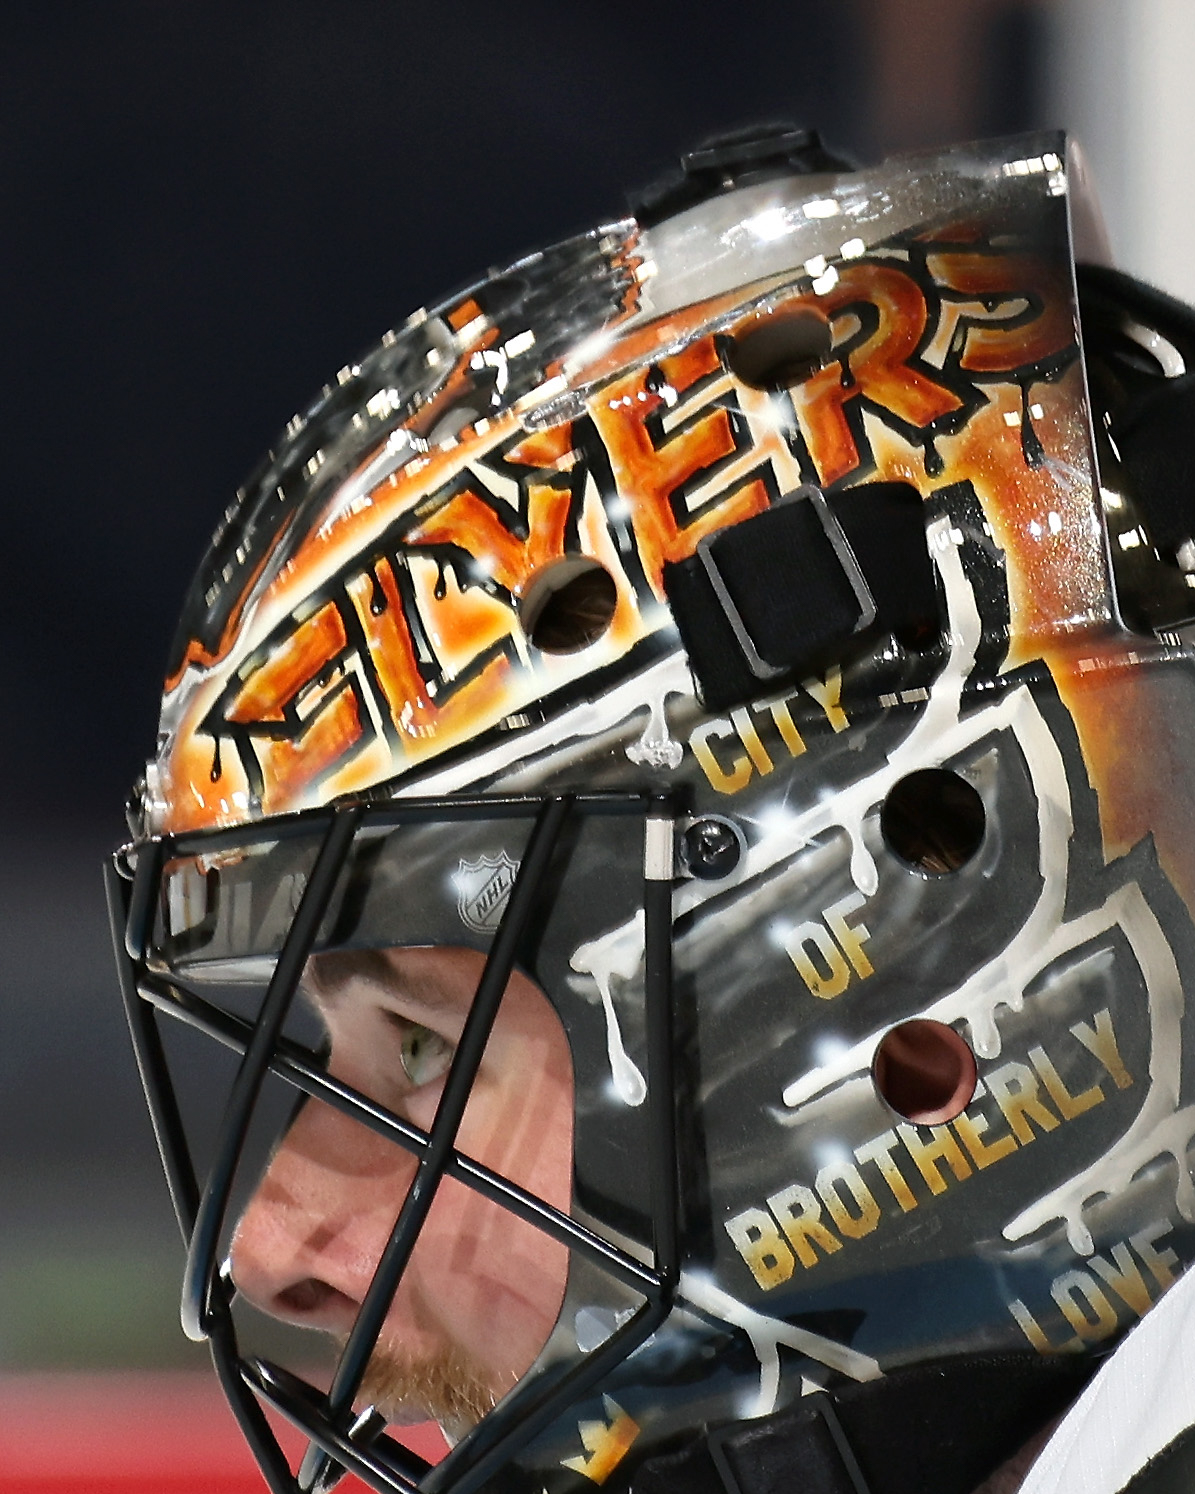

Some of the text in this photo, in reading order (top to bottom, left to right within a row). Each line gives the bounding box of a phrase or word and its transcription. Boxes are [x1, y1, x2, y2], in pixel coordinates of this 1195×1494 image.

[691, 666, 852, 795] CITY
[475, 876, 509, 919] NHL
[784, 894, 879, 1000] OF
[723, 1007, 1135, 1292] BROTHERLY
[1008, 1217, 1189, 1356] LOVE
